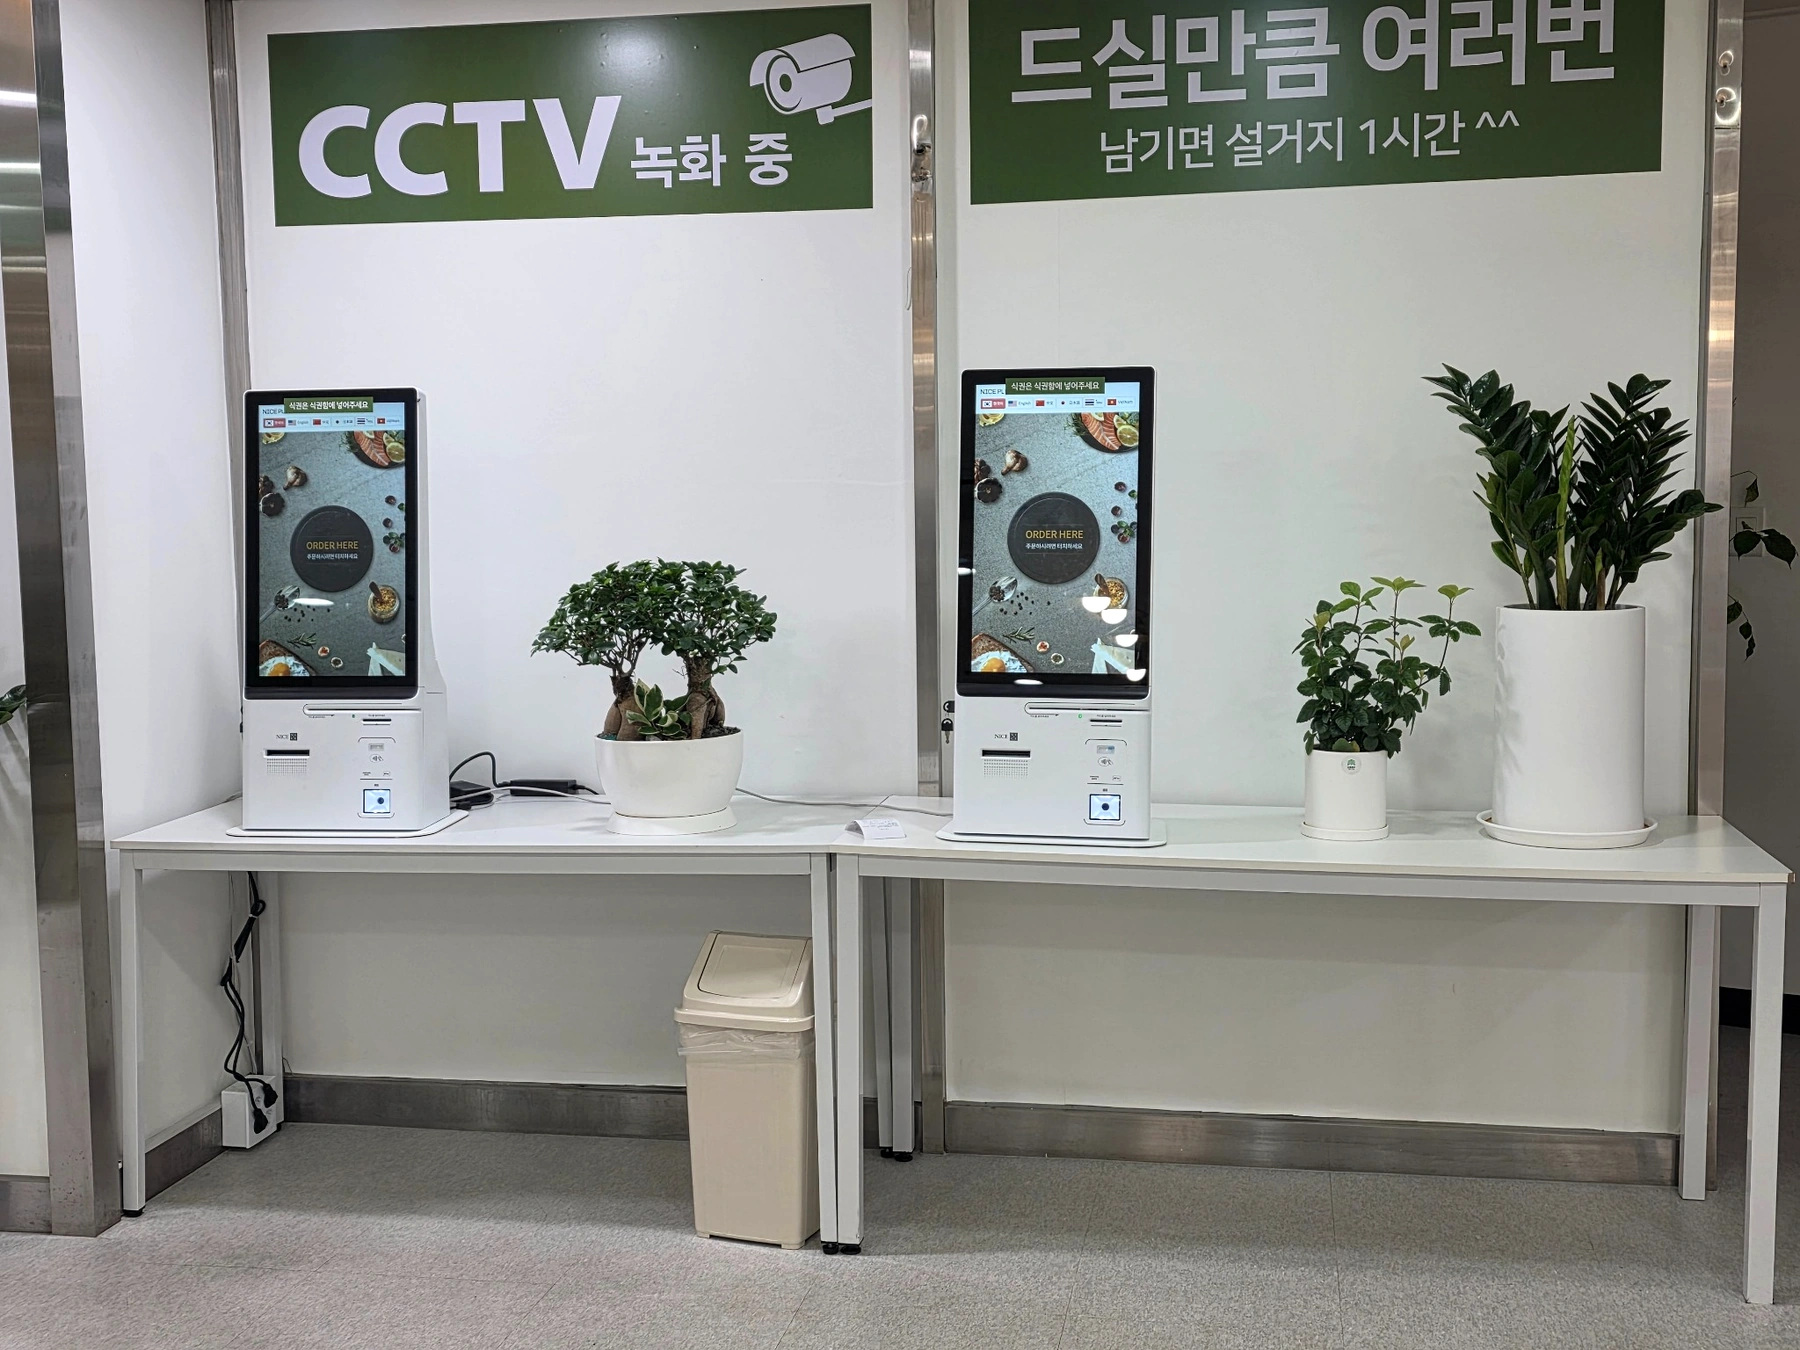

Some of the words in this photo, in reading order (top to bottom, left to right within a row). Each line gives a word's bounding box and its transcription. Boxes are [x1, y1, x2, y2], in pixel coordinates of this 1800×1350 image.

[1011, 7, 1340, 110] 드실만큼
[1362, 0, 1615, 91] 여러번
[298, 95, 622, 199] CCTV
[630, 133, 727, 188] 녹화
[744, 132, 793, 186] 중
[1100, 124, 1215, 175] 남기면
[1225, 117, 1344, 168] 설거지
[1359, 110, 1466, 159] 1시간
[1011, 381, 1032, 391] 식권은
[306, 541, 335, 550] ORDER
[336, 540, 359, 550] HERE
[1025, 530, 1057, 539] ORDER
[1059, 530, 1084, 539] HERE
